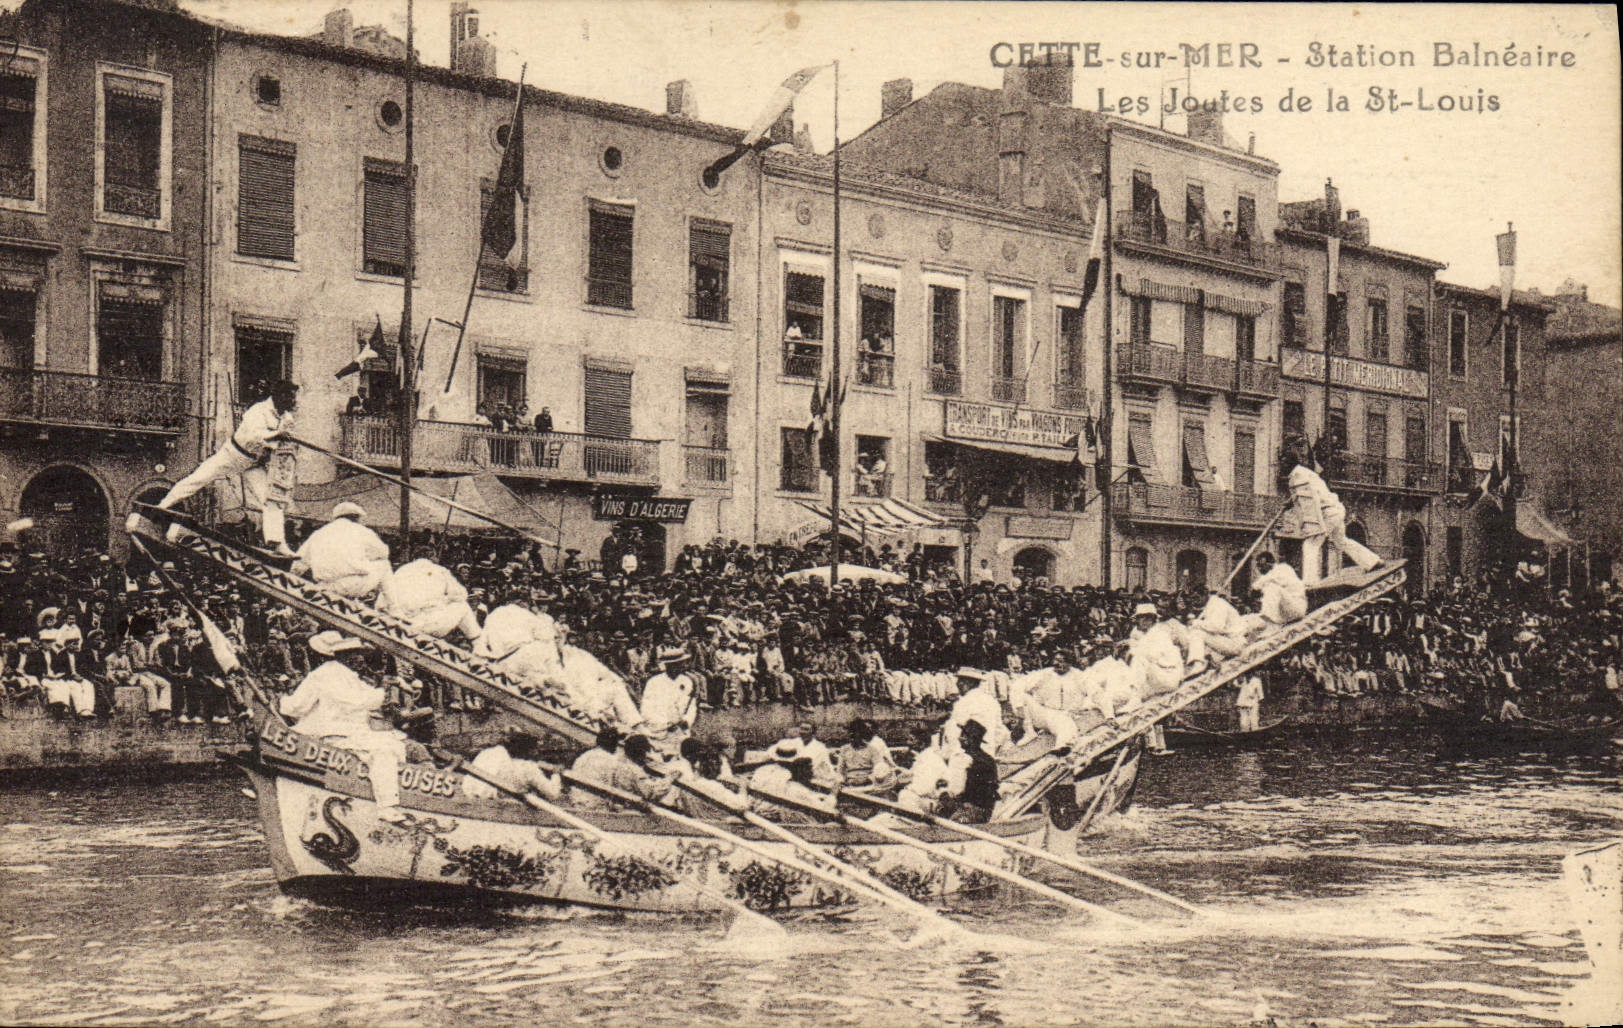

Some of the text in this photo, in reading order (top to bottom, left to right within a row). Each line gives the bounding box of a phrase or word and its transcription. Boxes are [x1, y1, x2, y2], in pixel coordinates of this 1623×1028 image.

[949, 402, 991, 426] TRANSPORT
[1001, 410, 1018, 428] VINS
[601, 500, 688, 519] VINS D'ALGERIE
[261, 722, 299, 755] LES
[304, 741, 351, 775] DEUX
